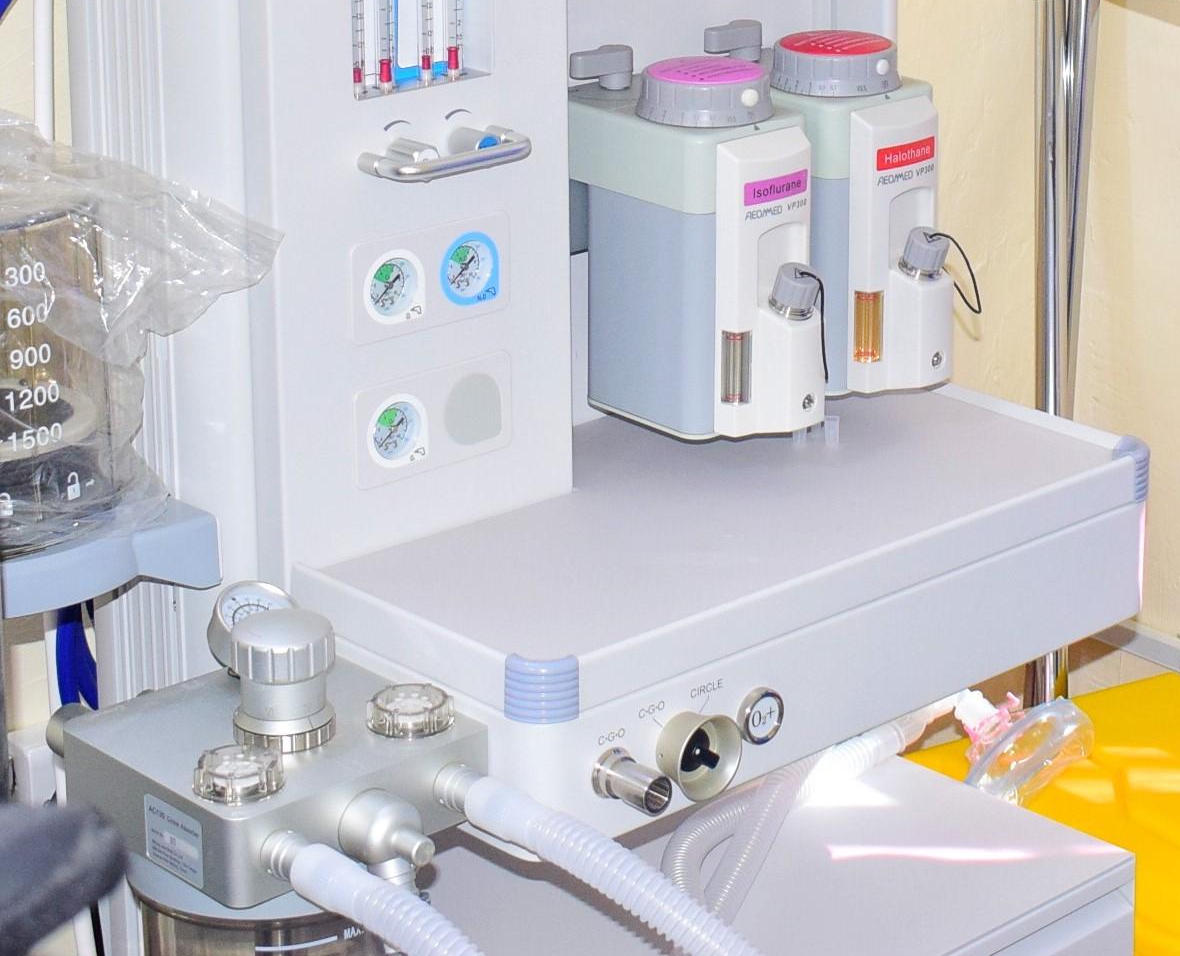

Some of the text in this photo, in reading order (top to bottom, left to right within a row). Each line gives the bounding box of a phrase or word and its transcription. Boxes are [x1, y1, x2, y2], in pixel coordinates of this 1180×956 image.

[884, 146, 930, 164] Halothane
[753, 180, 801, 198] Isoflurane
[5, 262, 46, 286] 300
[7, 303, 48, 329] 600
[10, 344, 51, 370] 900
[5, 383, 59, 411] 1200
[8, 423, 62, 451] 1500
[691, 678, 723, 698] CIRCLE
